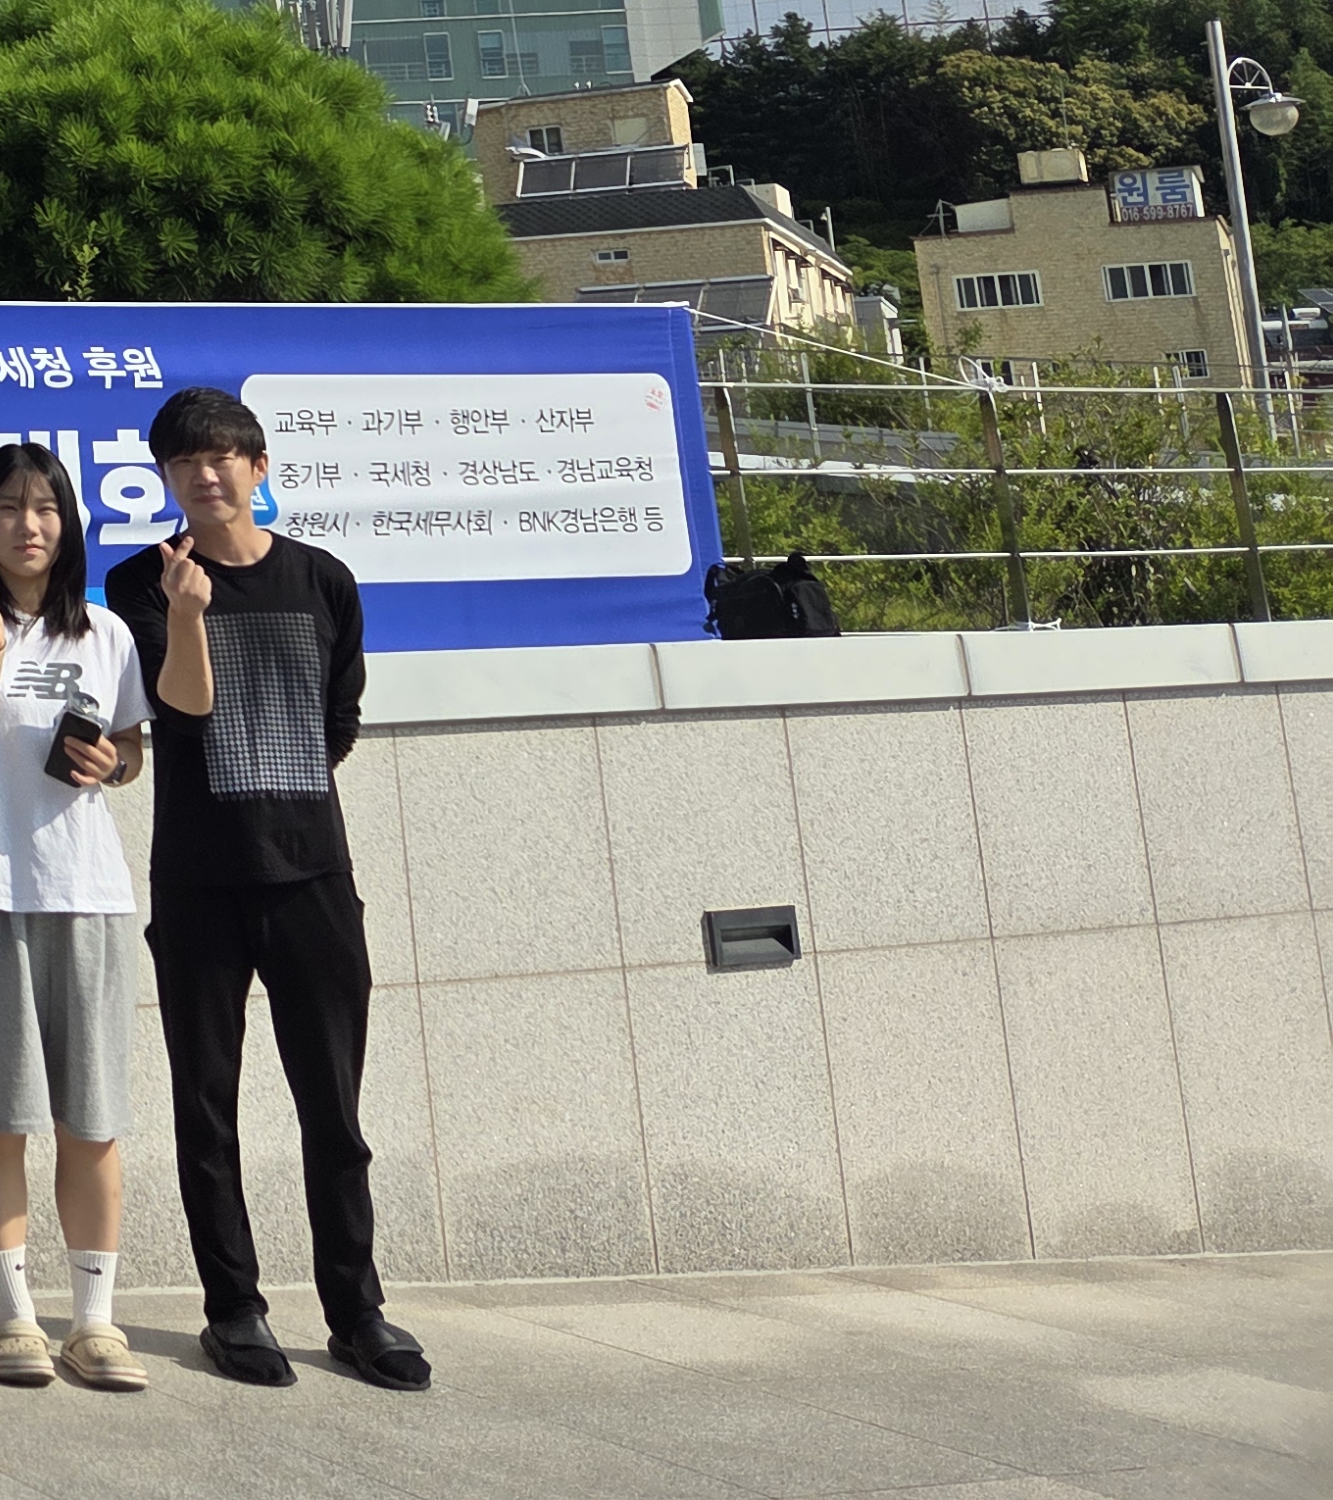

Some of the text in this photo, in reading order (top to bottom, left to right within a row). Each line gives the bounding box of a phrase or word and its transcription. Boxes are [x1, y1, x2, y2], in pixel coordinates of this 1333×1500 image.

[1117, 169, 1191, 207] 원룸
[82, 347, 163, 389] 후원
[275, 408, 595, 436] 교육부 과기부 행안부 산자부
[279, 457, 654, 489] 중기부 국세청 경상남도 경남교육청
[285, 506, 664, 538] 창원시 한국세무사회 BNK경남은행 등
